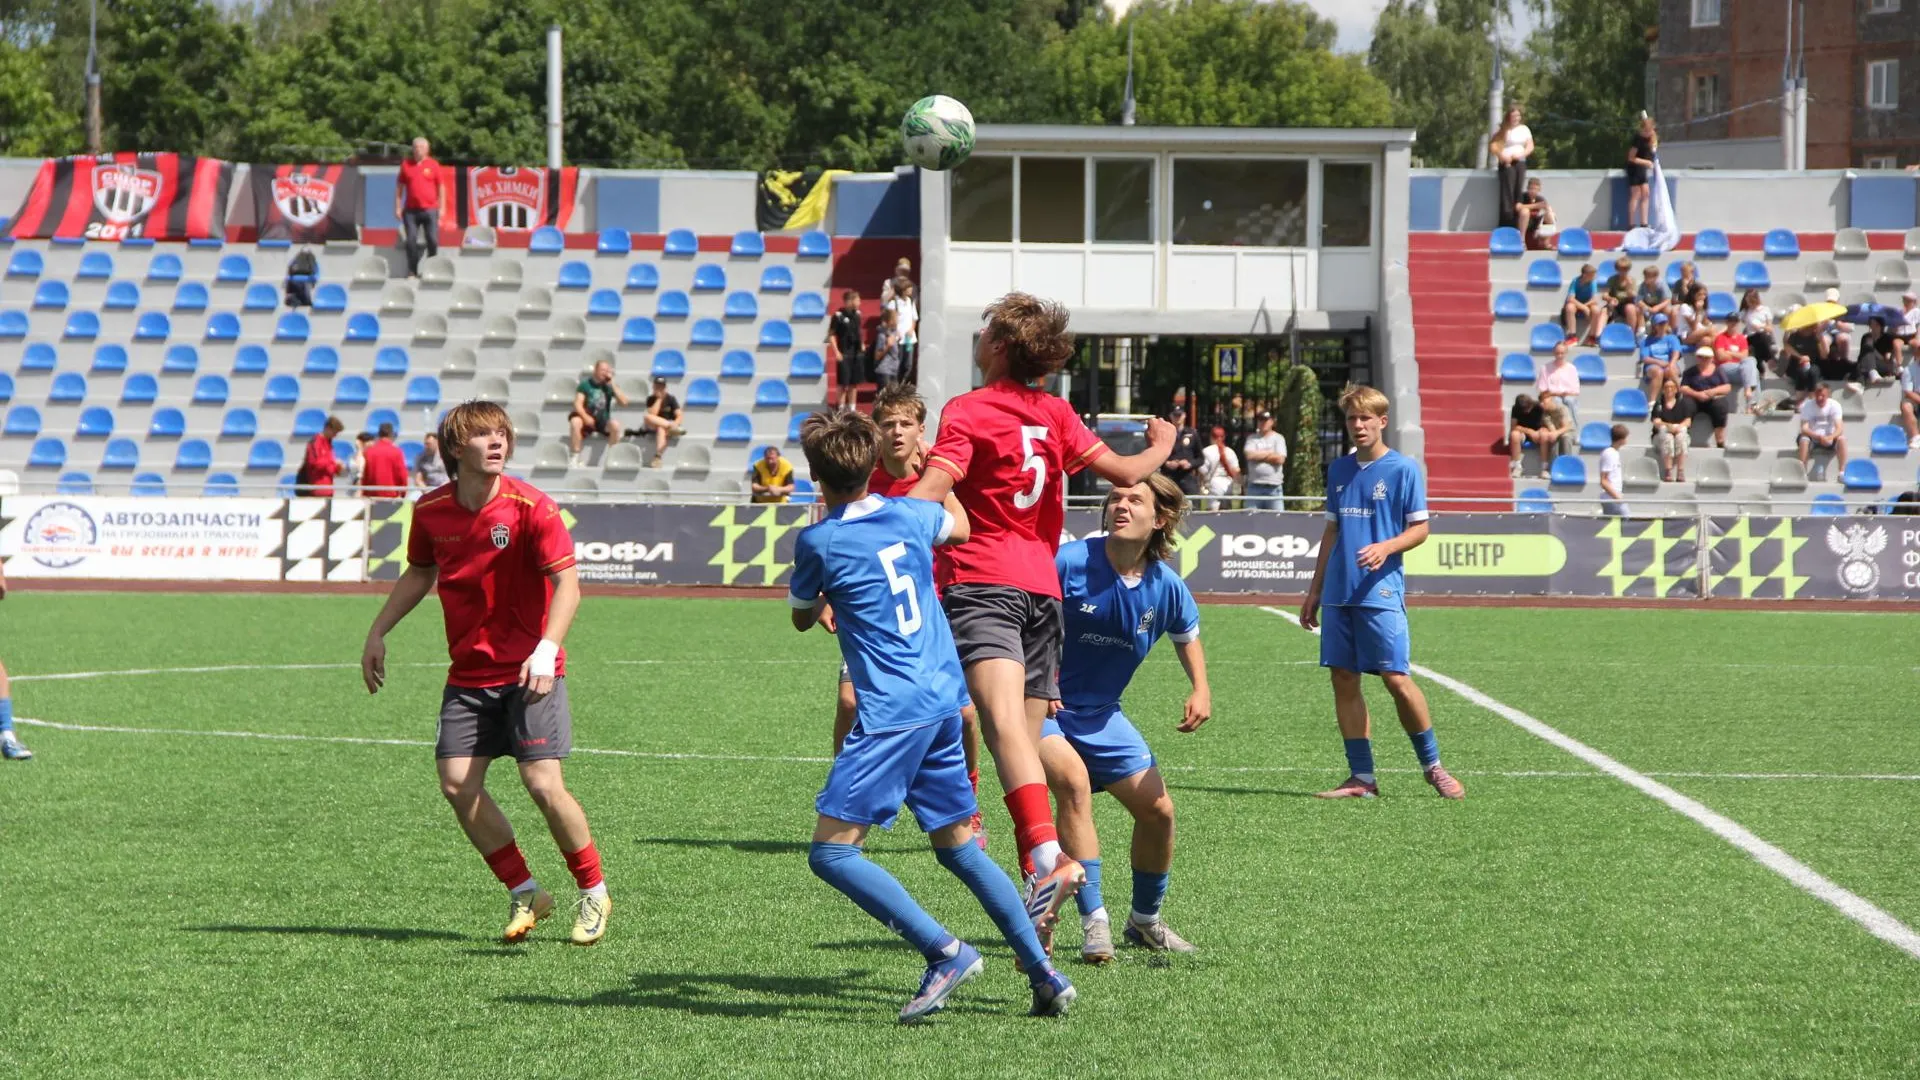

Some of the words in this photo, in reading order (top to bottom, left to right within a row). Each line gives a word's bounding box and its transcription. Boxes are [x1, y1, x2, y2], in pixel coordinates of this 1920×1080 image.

[496, 181, 538, 199] ХИМКИ
[84, 221, 143, 238] 2011
[1013, 425, 1049, 509] 5
[102, 511, 261, 527] АВТОЗАПЧАСТИ
[102, 530, 117, 539] НА
[574, 542, 673, 562] ЮФЛ
[1437, 542, 1505, 570] ЦЕНТР
[1222, 561, 1295, 570] ЮНОШЕСКАЯ
[1222, 570, 1295, 579] ФУТБОЛЬНАЯ
[1295, 570, 1316, 580] ЛИГ
[877, 542, 923, 636] 5
